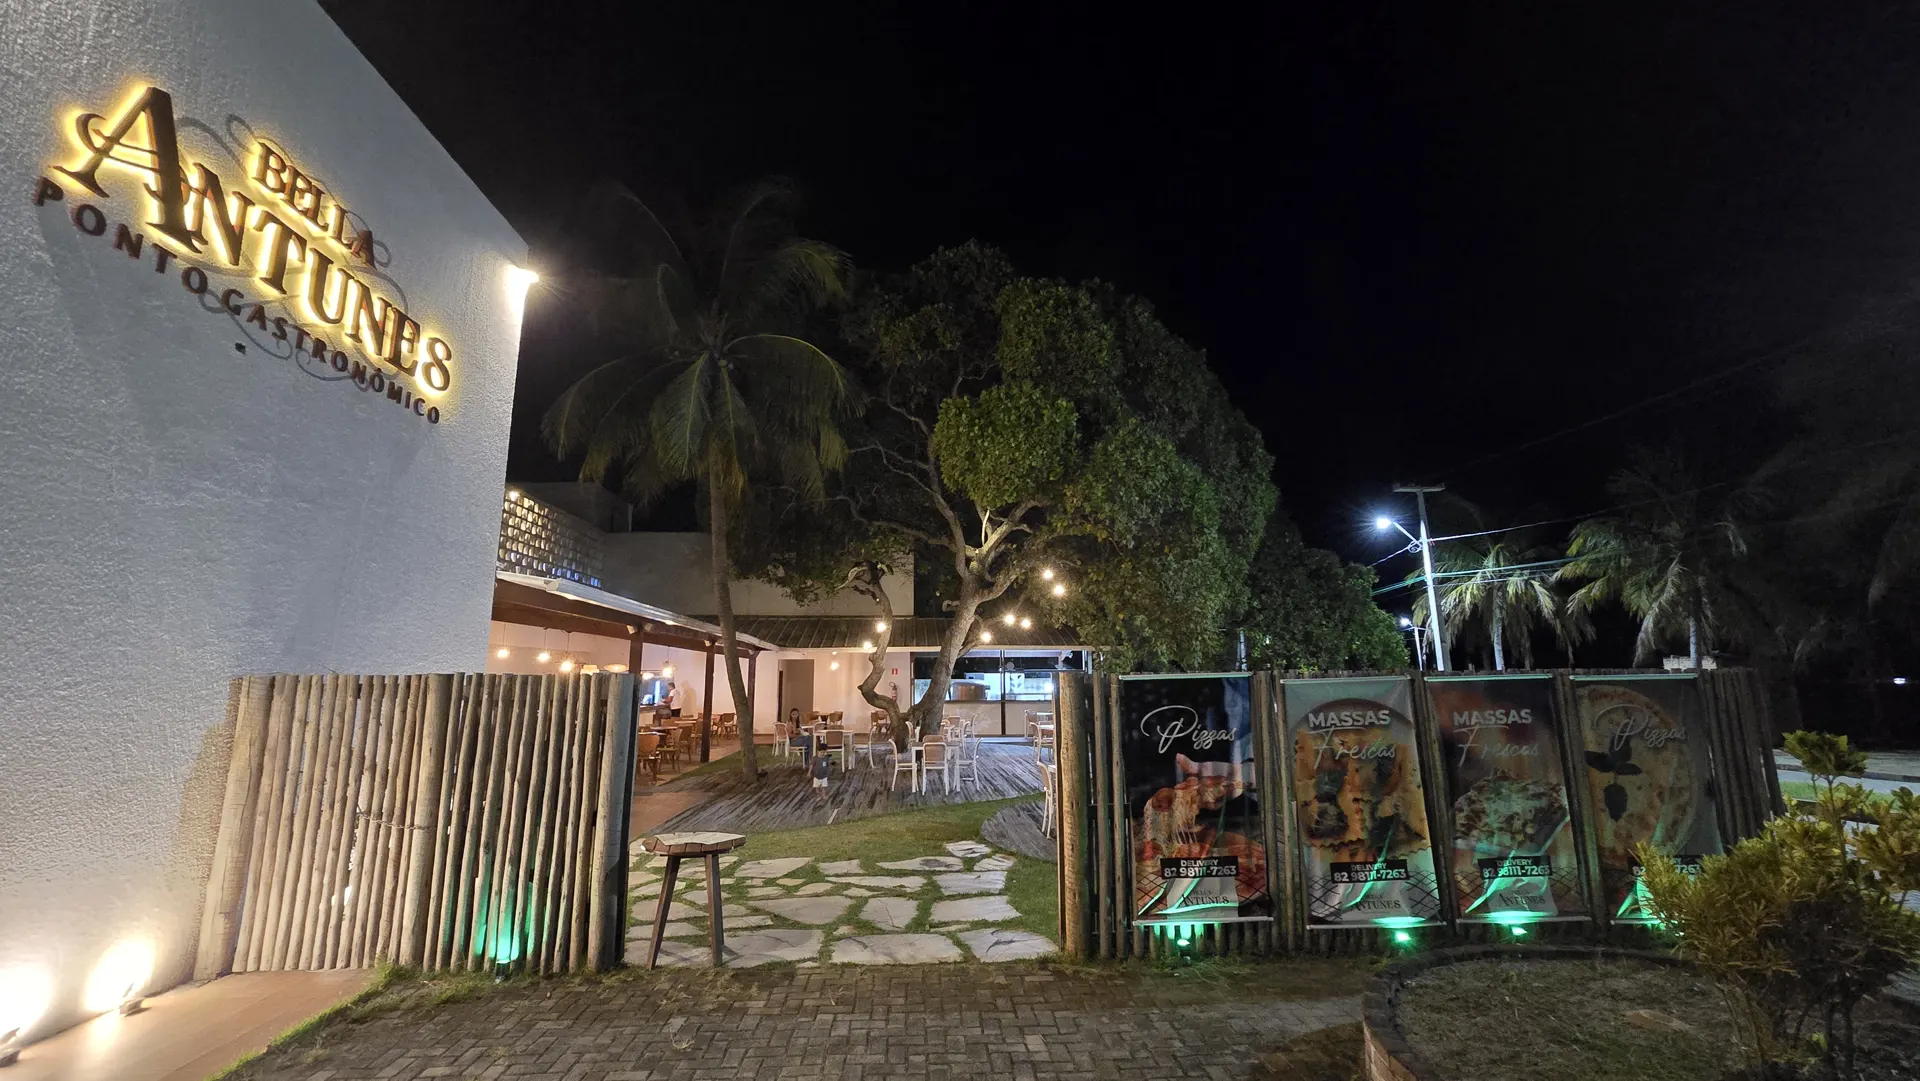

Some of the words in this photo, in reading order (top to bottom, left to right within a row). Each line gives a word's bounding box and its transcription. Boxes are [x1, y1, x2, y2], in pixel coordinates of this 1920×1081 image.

[252, 141, 377, 269] BELLA
[50, 86, 453, 392] ANTUNES
[33, 176, 209, 294] PONTO
[220, 288, 441, 424] GASTRONÔMICO
[1308, 709, 1391, 728] MASSAS
[1452, 708, 1533, 726] MASSAS
[1140, 705, 1237, 754] Pizzas
[1593, 704, 1688, 751] Pizzas
[1306, 725, 1398, 770] Frescas
[1164, 867, 1178, 877] 82
[1179, 865, 1237, 877] 98111-7263
[1180, 859, 1219, 867] DELIVERY
[1350, 862, 1387, 871] DELIVERY
[1482, 867, 1496, 878] 82
[1333, 871, 1350, 882] 82
[1350, 868, 1407, 881] 98111-7263
